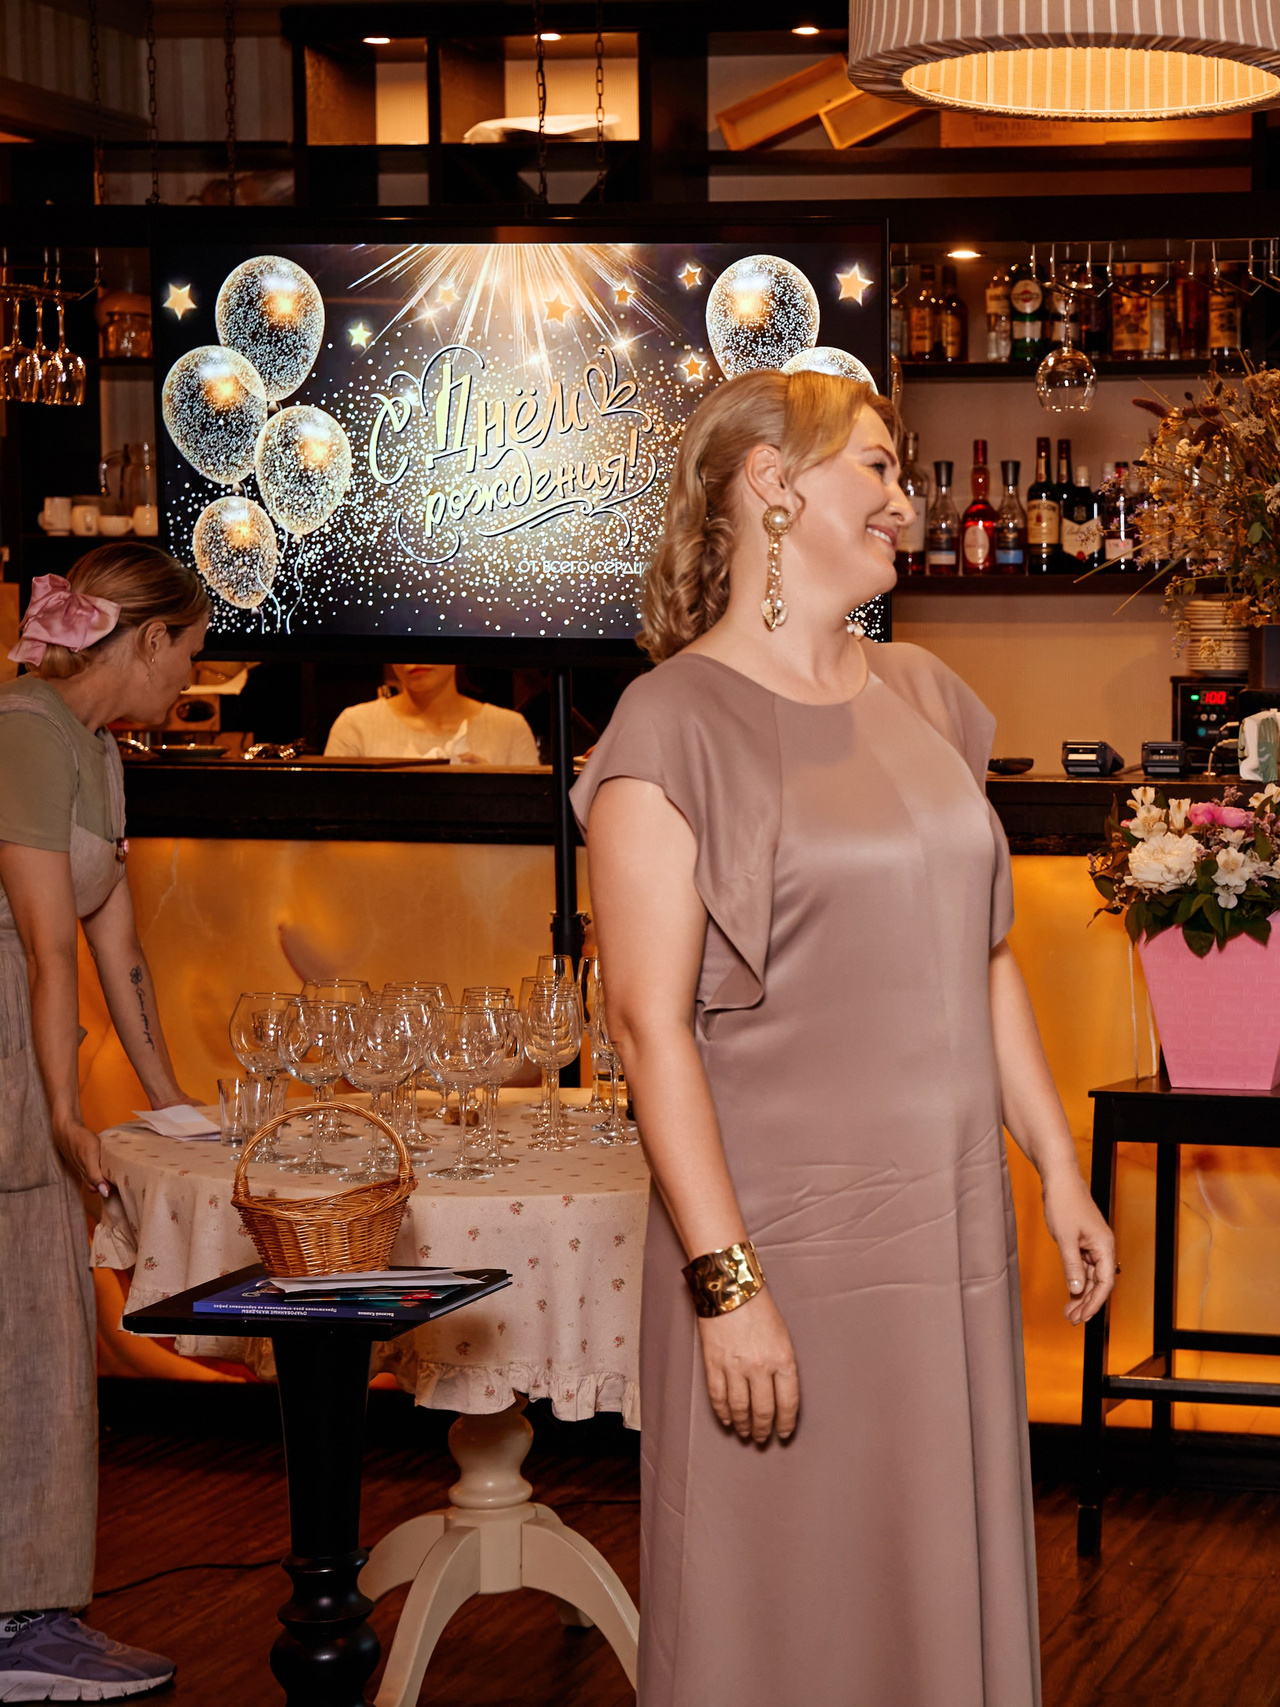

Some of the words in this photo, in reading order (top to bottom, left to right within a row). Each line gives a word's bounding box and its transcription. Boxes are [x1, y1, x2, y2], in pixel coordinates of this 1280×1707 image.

[369, 393, 412, 485] С
[425, 361, 588, 473] Днём
[424, 428, 640, 538] рождения!
[518, 560, 539, 574] ОТ
[1205, 690, 1227, 705] 100
